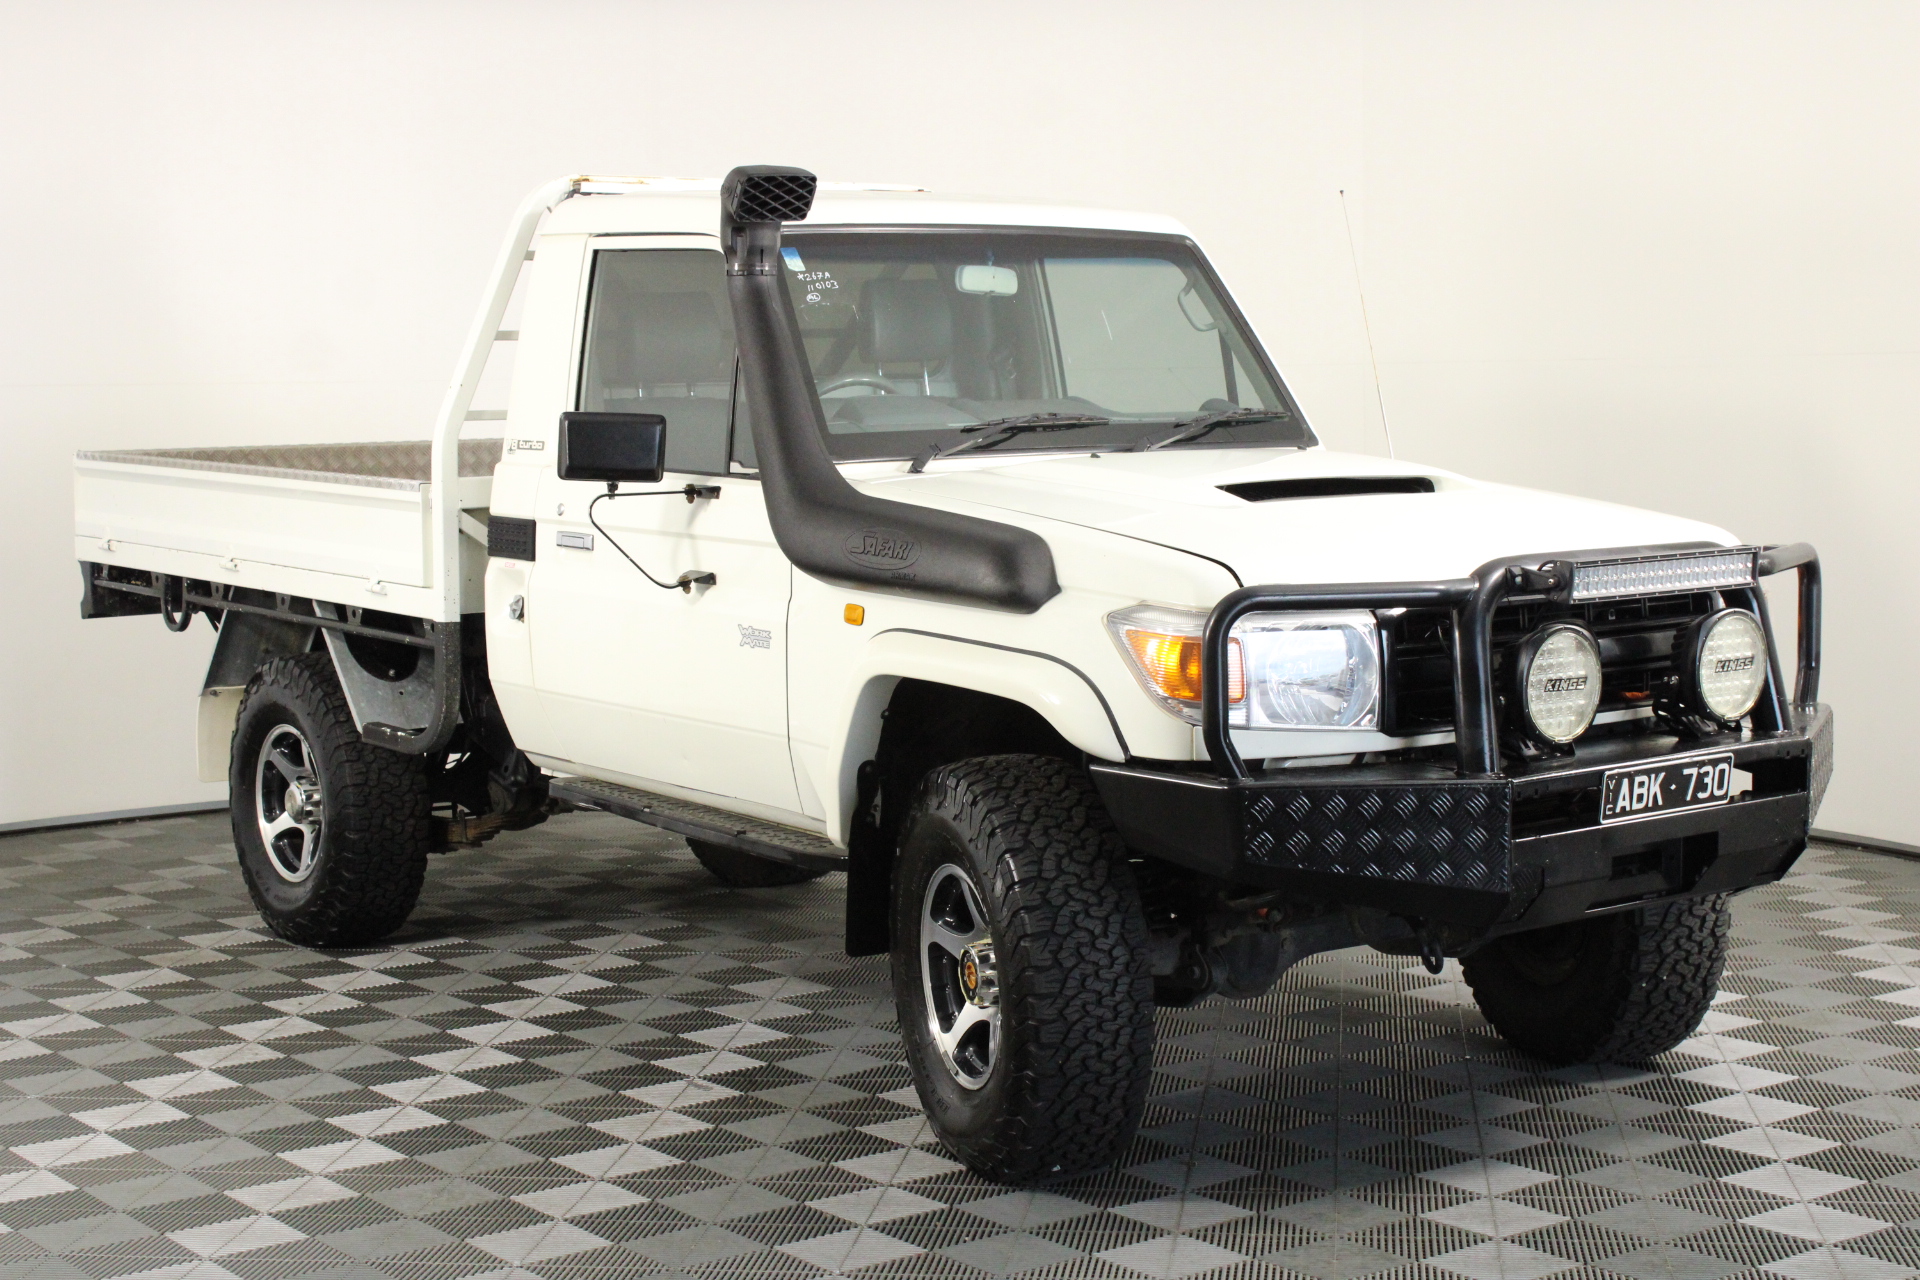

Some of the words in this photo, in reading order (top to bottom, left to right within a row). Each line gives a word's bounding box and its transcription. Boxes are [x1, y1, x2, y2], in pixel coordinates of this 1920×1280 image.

[518, 440, 544, 450] turbo
[850, 530, 914, 560] SAFARI
[738, 624, 772, 639] WORK
[740, 635, 771, 649] MATE
[1715, 656, 1754, 673] KINGS
[1544, 676, 1587, 692] KINGS
[1605, 780, 1616, 815] VIC
